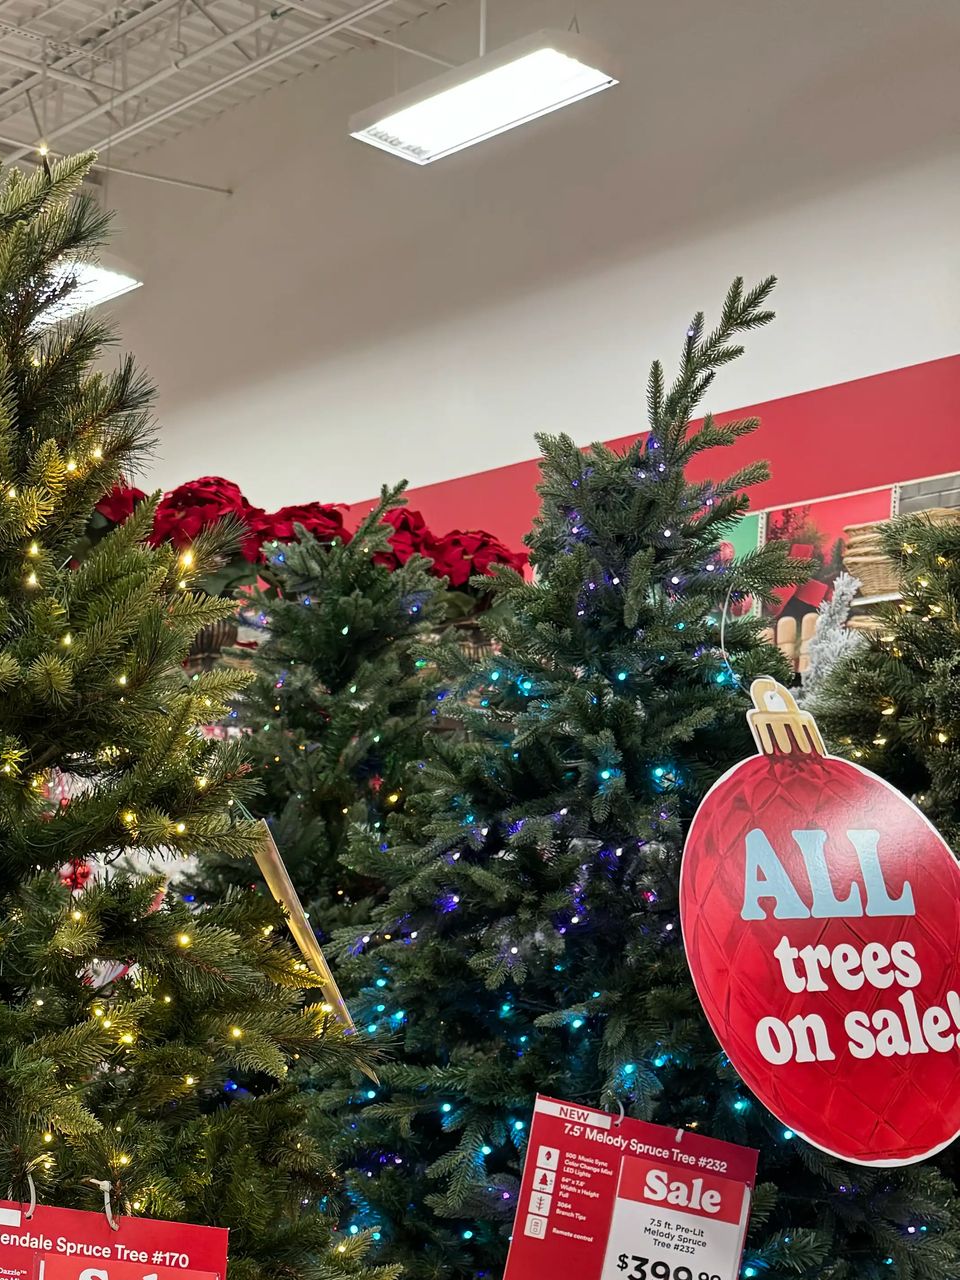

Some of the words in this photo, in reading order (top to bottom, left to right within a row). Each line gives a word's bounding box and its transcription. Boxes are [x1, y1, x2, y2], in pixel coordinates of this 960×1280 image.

[741, 828, 916, 920] ALL
[774, 935, 922, 994] trees
[755, 1013, 836, 1065] on
[559, 1106, 590, 1122] NEW
[563, 1122, 584, 1137] 7.5'
[585, 1127, 628, 1151] Melody
[629, 1138, 669, 1158] Spruce
[671, 1148, 696, 1165] Tree
[697, 1156, 727, 1173] #232
[643, 1169, 721, 1213] Sale
[643, 1226, 676, 1241] Melody
[677, 1234, 707, 1248] Spruce
[649, 1218, 662, 1228] 7.5
[663, 1221, 673, 1231] ft.
[675, 1224, 704, 1238] Pre-Lit
[653, 1238, 672, 1249] Tree
[673, 1243, 695, 1255] #232
[56, 1237, 111, 1258] Spruce
[114, 1244, 148, 1263] Tree
[151, 1250, 189, 1268] #170
